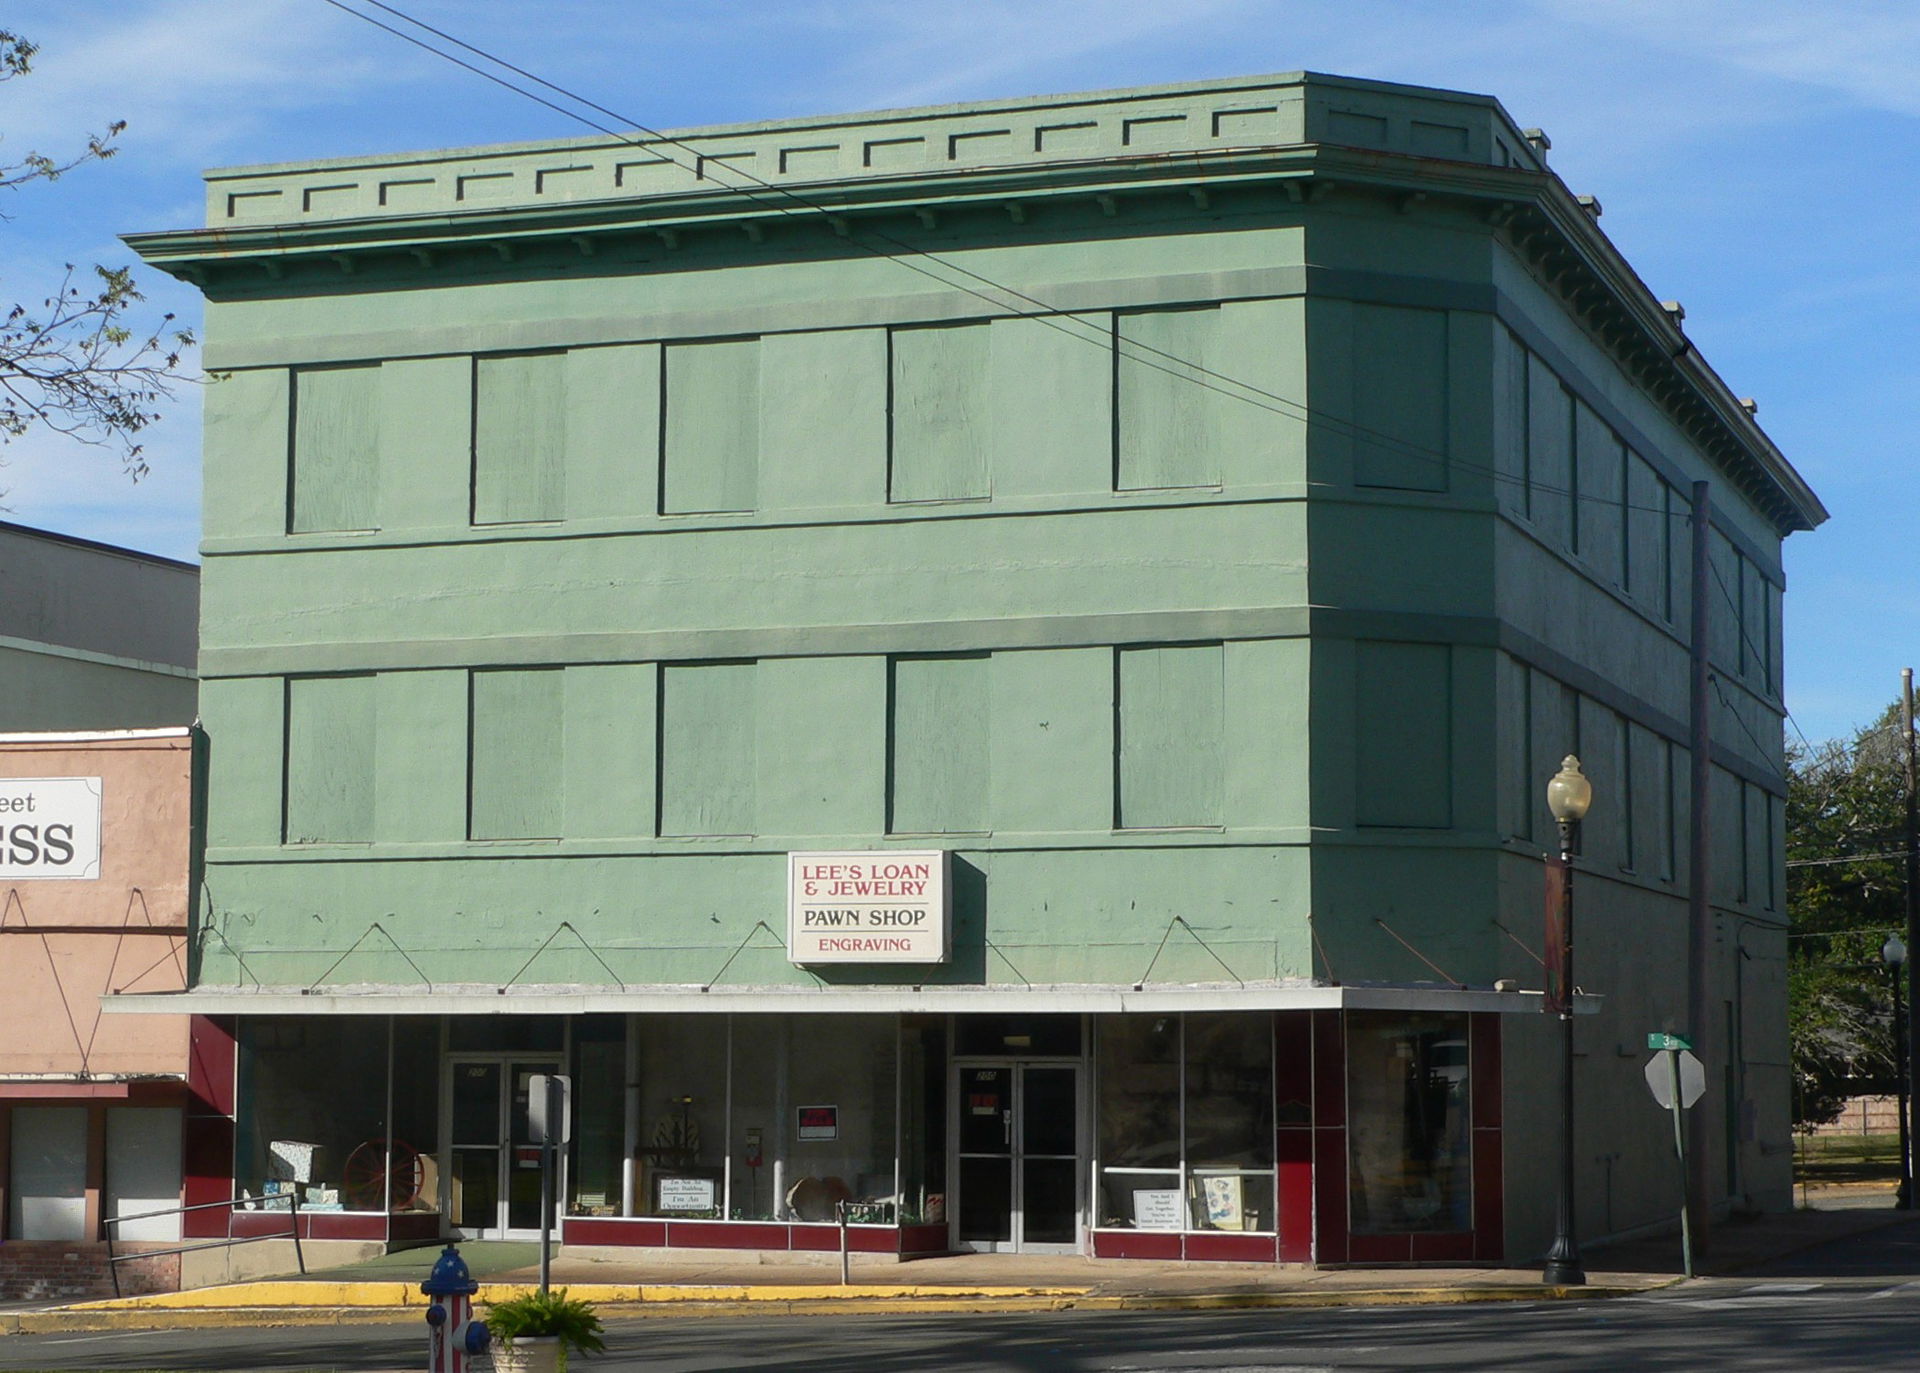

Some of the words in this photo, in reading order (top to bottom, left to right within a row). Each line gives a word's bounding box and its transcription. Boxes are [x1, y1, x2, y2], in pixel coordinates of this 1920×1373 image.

[0, 823, 75, 866] SS
[802, 865, 862, 880] LEE'S
[871, 864, 930, 879] LOAN
[804, 881, 818, 896] &
[828, 881, 927, 896] JEWELRY
[804, 910, 860, 926] PAWN
[869, 910, 926, 926] SHOP
[818, 938, 912, 951] ENGRAVING
